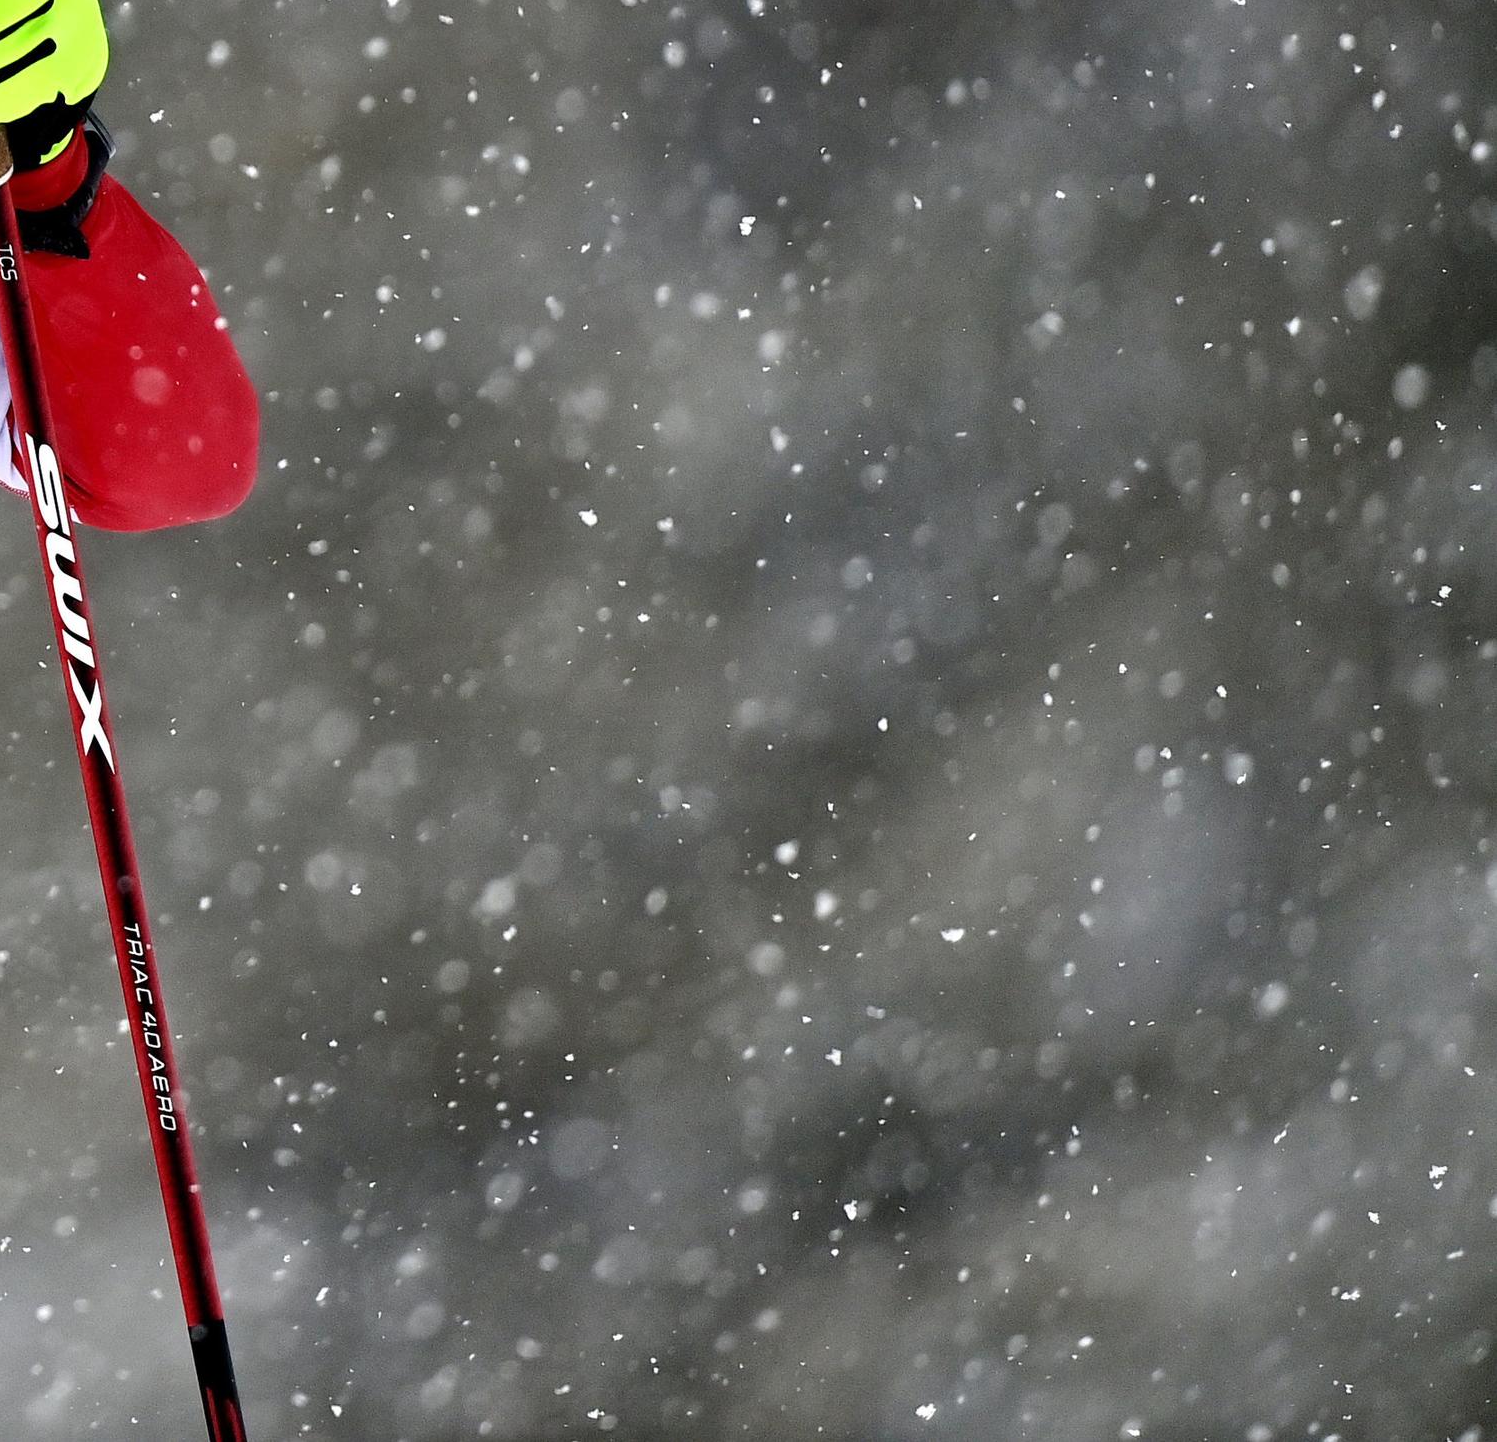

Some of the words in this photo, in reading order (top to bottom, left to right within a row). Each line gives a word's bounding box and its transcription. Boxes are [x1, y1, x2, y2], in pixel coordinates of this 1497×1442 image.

[24, 431, 116, 775] SWIX
[123, 922, 154, 1006] TRIAC
[141, 1011, 162, 1050] 4.0
[147, 1053, 178, 1132] AERO
